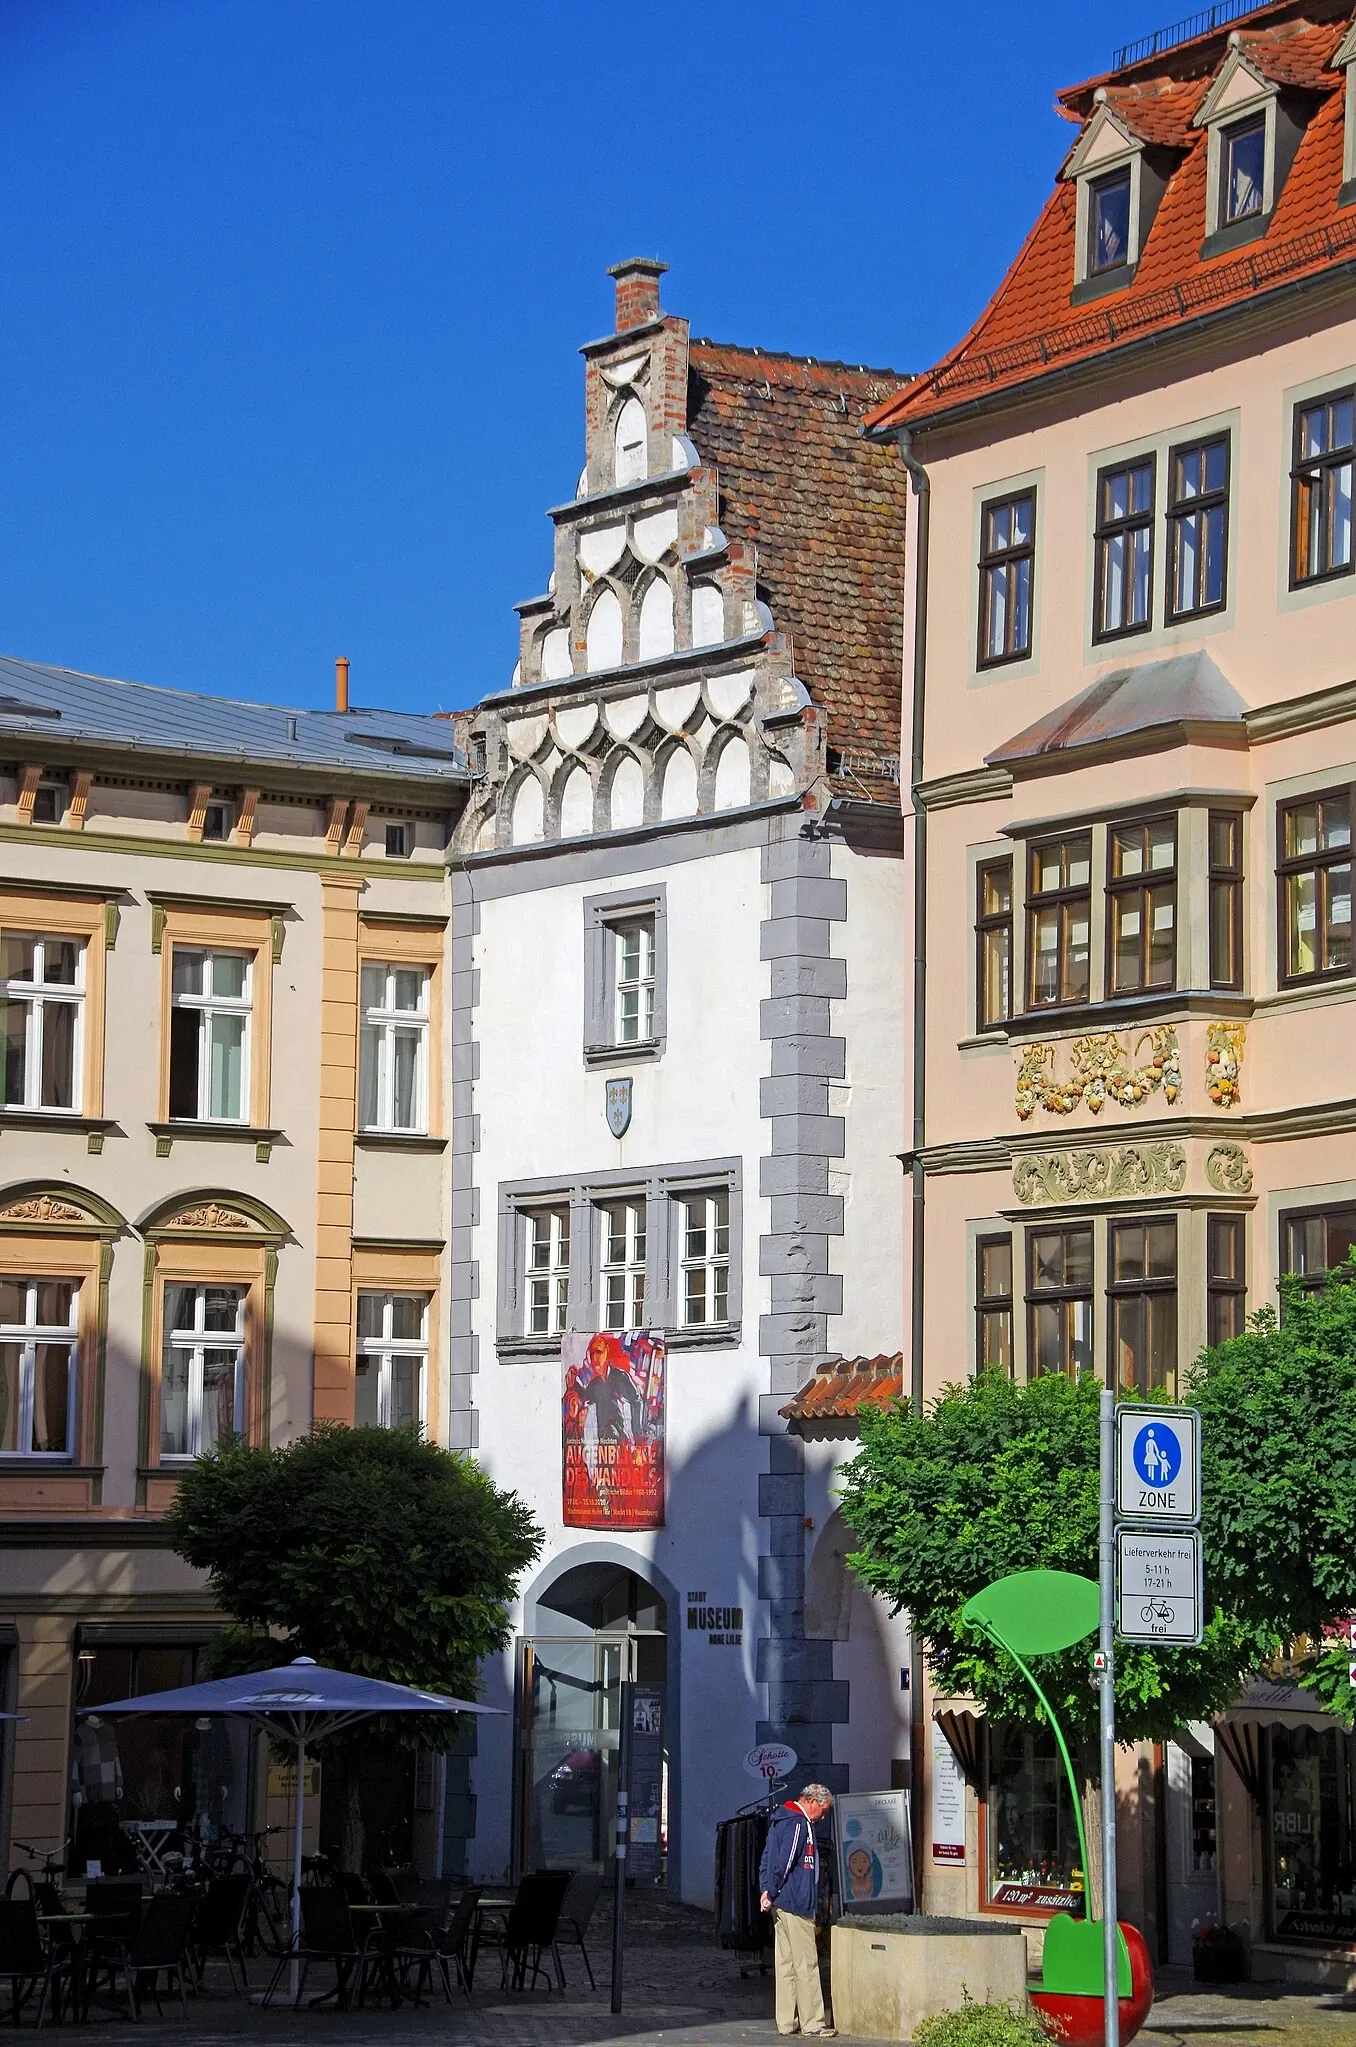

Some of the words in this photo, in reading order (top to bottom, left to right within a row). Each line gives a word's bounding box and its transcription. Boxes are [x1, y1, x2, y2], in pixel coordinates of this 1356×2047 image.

[1139, 1491, 1176, 1508] ZONE
[1124, 1547, 1176, 1559] Lieferverkehr
[1178, 1550, 1191, 1560] frei
[1145, 1564, 1162, 1574] 5-11
[1164, 1565, 1170, 1574] h
[1144, 1577, 1164, 1588] 17-21
[1167, 1580, 1172, 1588] h
[687, 1591, 706, 1602] STADT
[687, 1607, 743, 1630] MUSEUM
[1151, 1623, 1167, 1634] frei
[226, 1693, 326, 1703] AZUL
[1002, 1889, 1019, 1902] 120
[1035, 1894, 1080, 1908] zusätzlich
